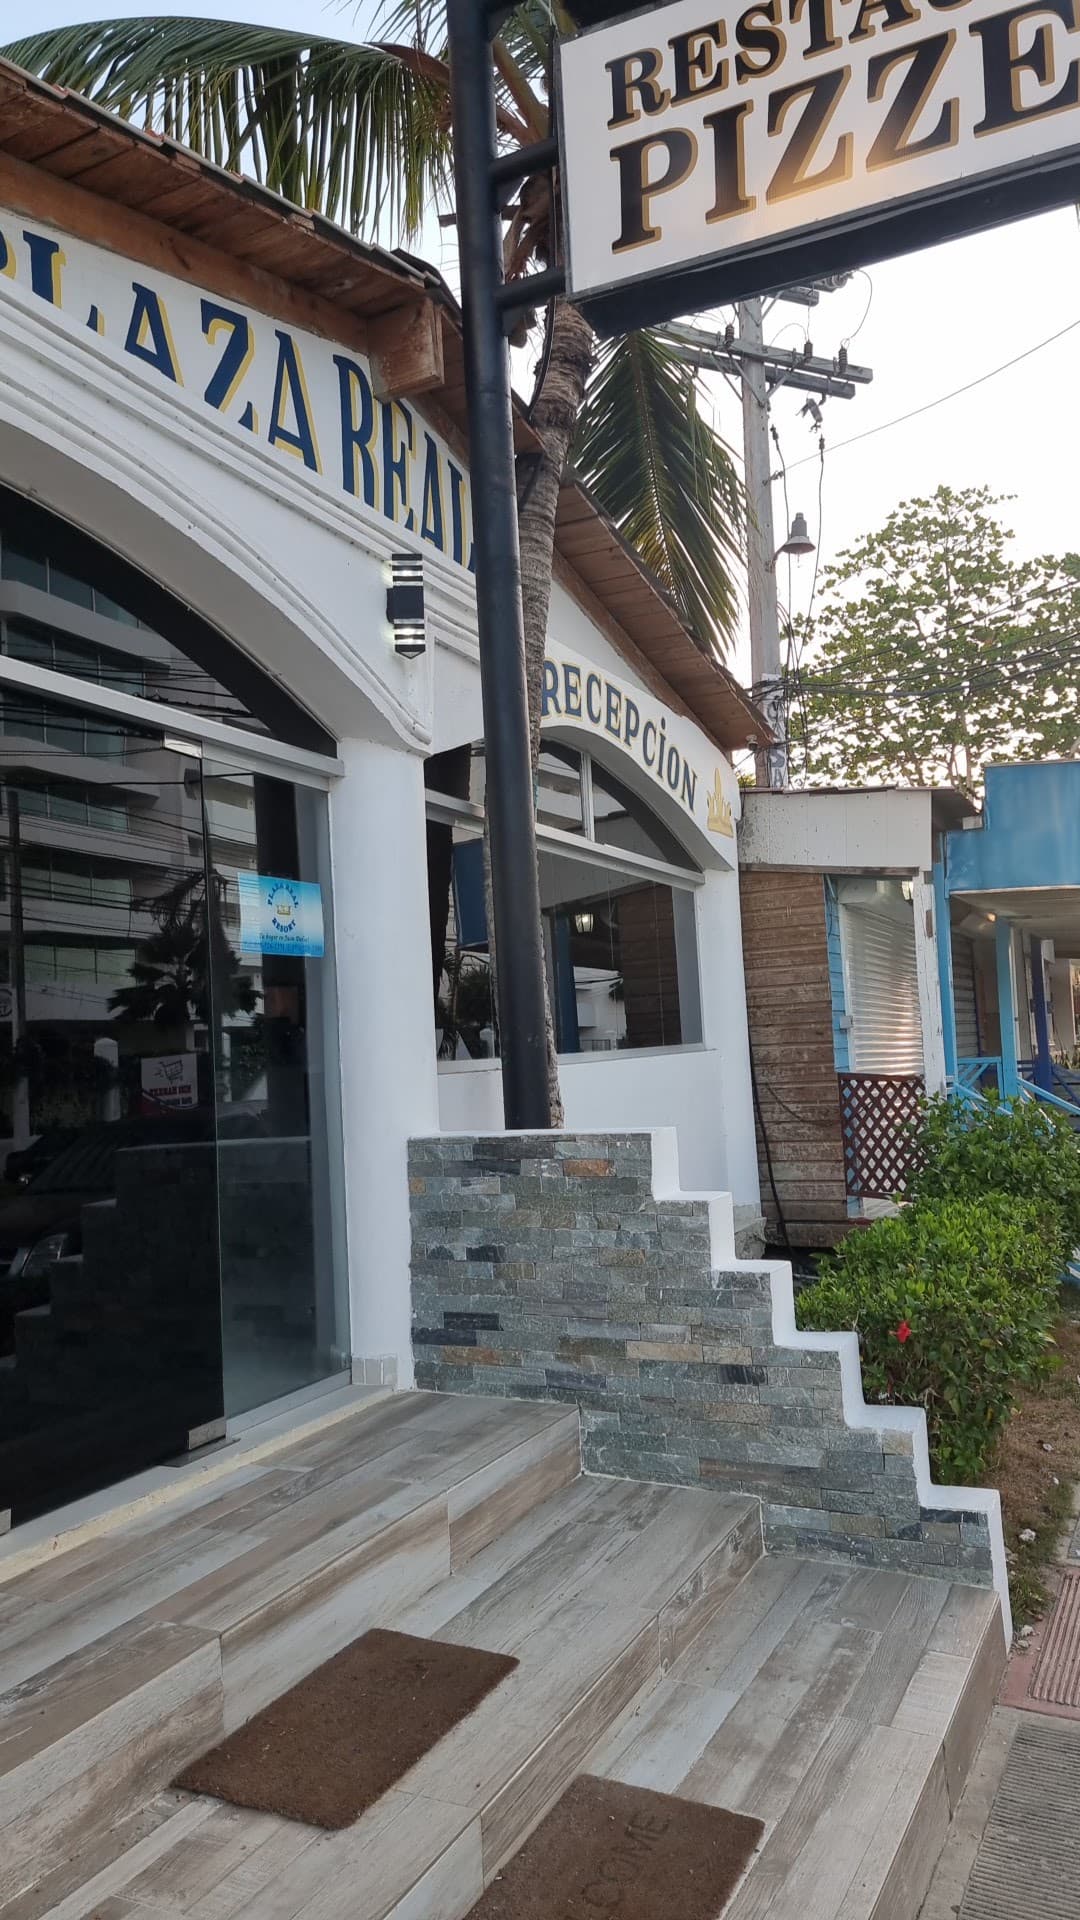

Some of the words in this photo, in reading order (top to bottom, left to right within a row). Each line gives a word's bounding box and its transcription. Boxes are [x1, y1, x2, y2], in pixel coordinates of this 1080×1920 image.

[605, 0, 972, 130] RESTA
[332, 354, 476, 572] REAL
[271, 917, 297, 933] RESORT
